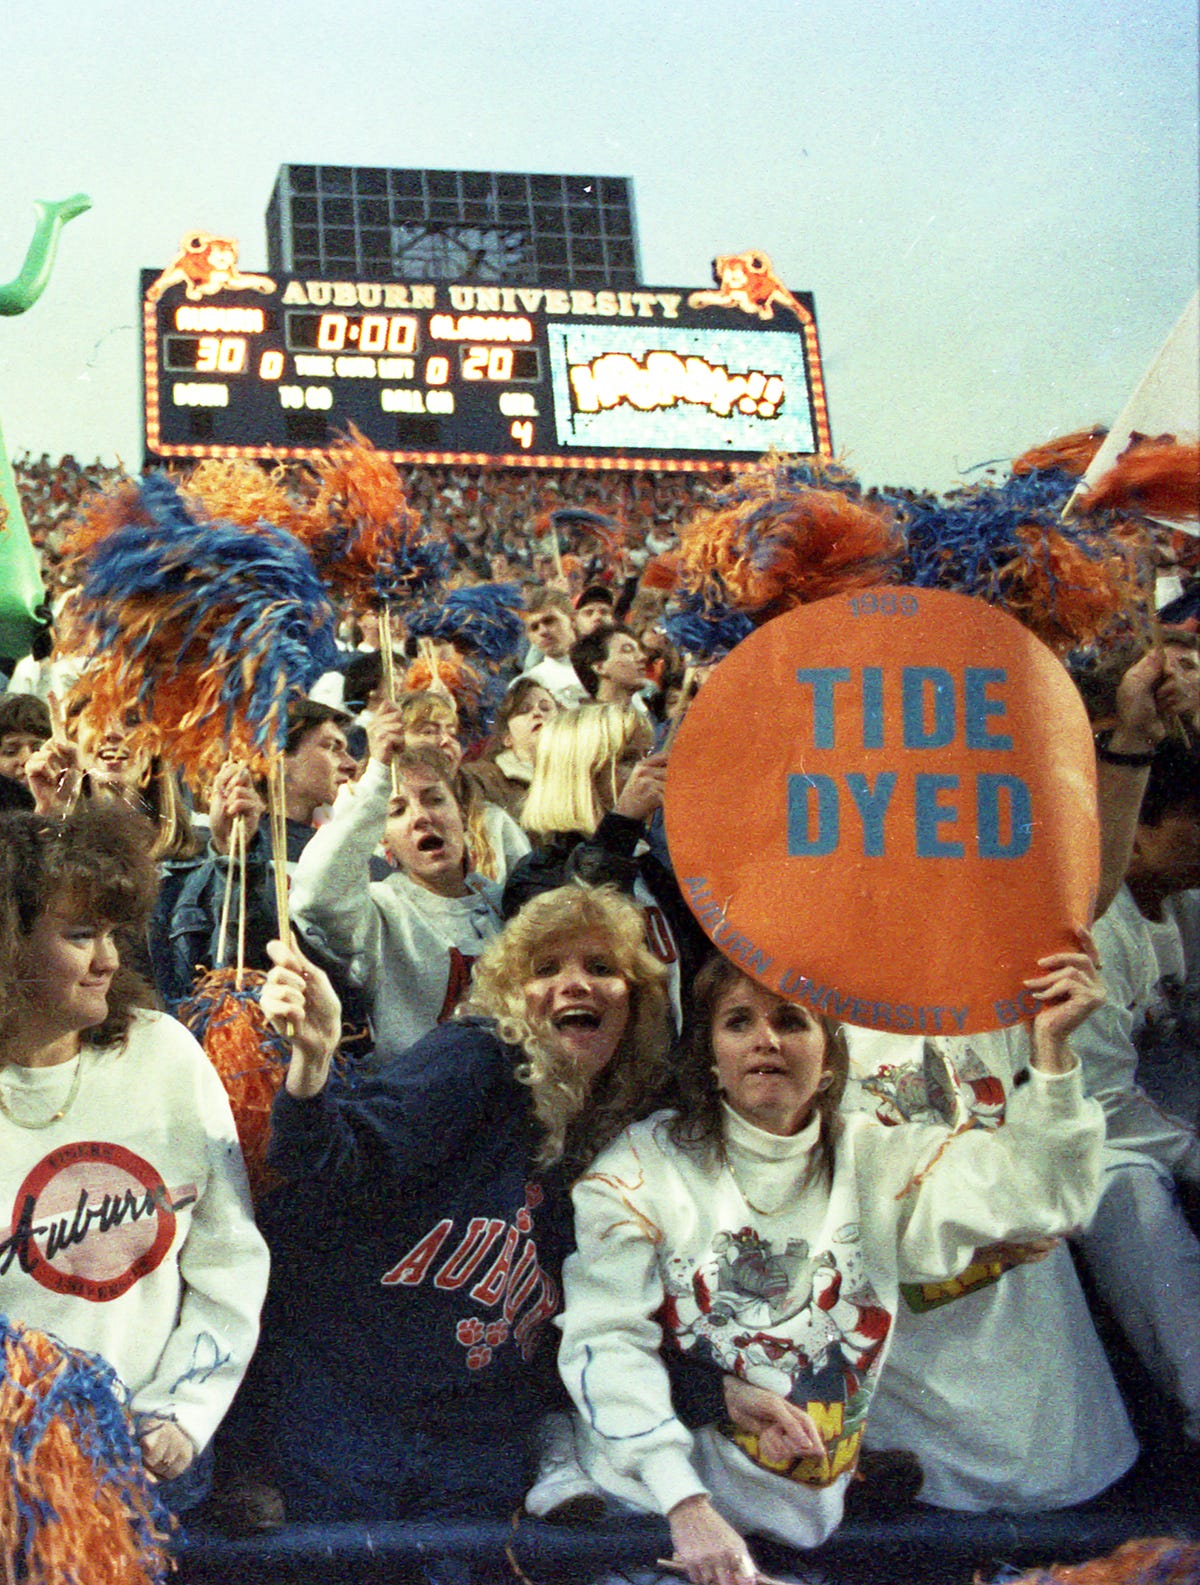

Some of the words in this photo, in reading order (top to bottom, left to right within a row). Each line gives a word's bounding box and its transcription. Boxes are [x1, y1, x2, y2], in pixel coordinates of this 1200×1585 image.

[281, 281, 436, 309] AUBURN
[449, 285, 683, 319] UNIVERSITY
[317, 314, 418, 352] 0:00
[196, 336, 248, 373] 30
[259, 351, 285, 380] 0
[425, 356, 449, 385] 0
[461, 346, 515, 380] 20
[511, 420, 533, 449] 4
[847, 592, 919, 619] 1989
[796, 666, 1014, 751] TIDE
[785, 773, 1033, 859] DYED
[683, 877, 774, 975] AUBURN
[778, 968, 970, 1031] UNIVERSITY
[380, 1216, 560, 1362] AUBUR
